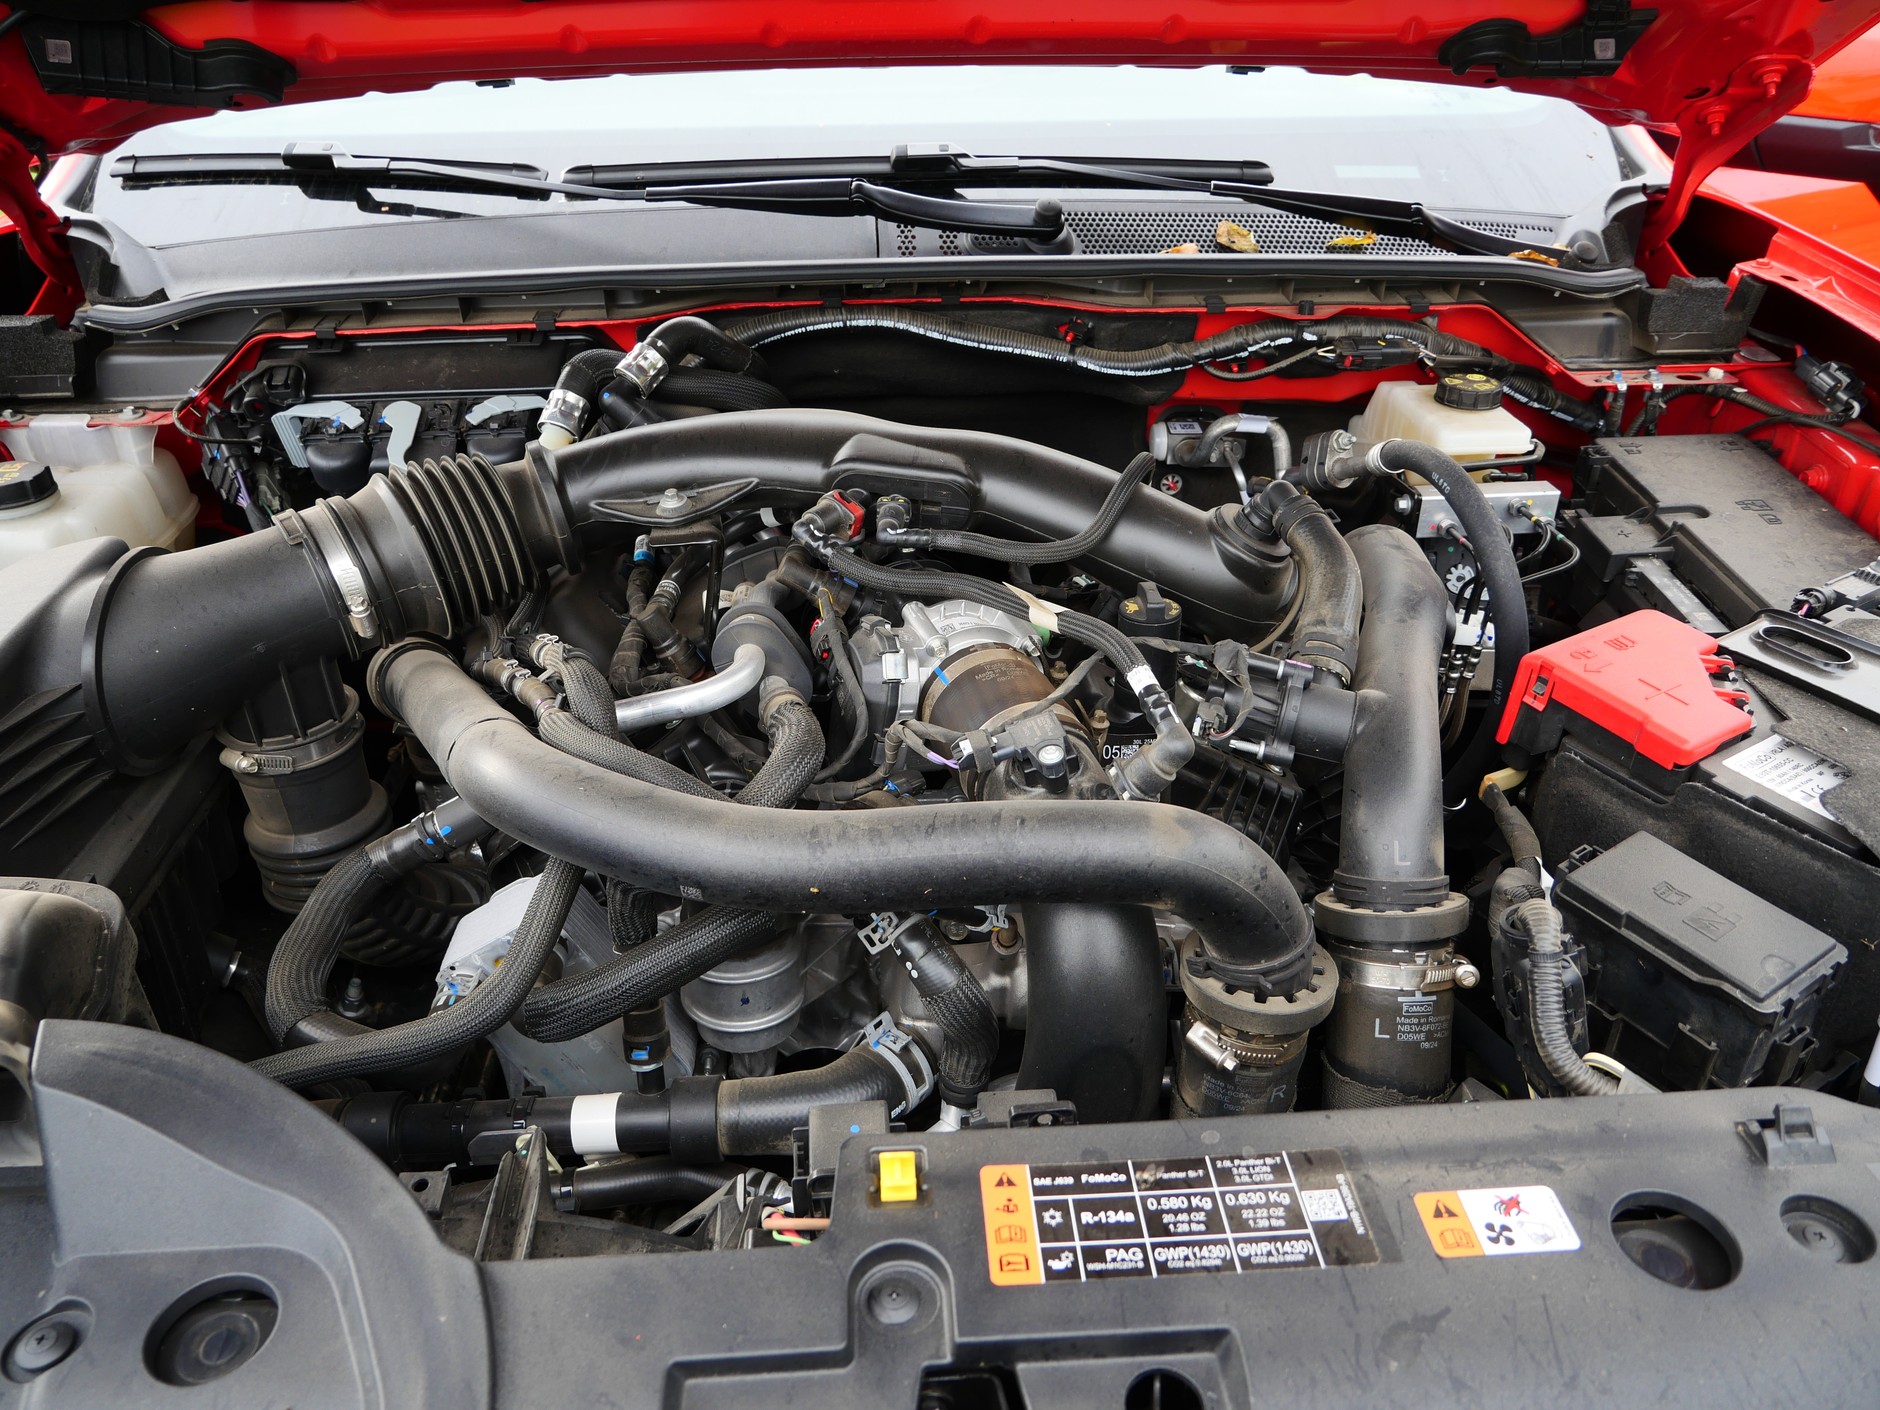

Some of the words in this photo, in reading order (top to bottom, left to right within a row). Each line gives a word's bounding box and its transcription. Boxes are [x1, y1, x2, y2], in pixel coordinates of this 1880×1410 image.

[1103, 745, 1120, 759] 05
[1393, 840, 1411, 866] L
[1403, 1005, 1432, 1013] FoMoCo
[1396, 1016, 1419, 1024] Made
[1375, 1018, 1390, 1039] L
[1397, 1032, 1426, 1041] D05WE
[1420, 1041, 1438, 1049] 09/24
[1203, 1073, 1225, 1088] Made
[1270, 1084, 1287, 1103] R
[1233, 1157, 1264, 1168] Panther
[1033, 1177, 1052, 1187] SAE
[1080, 1172, 1127, 1184] FoMoCo
[1146, 1196, 1189, 1211] 0.580
[1190, 1195, 1213, 1211] Kg
[1224, 1191, 1266, 1206] 0.630
[1268, 1190, 1291, 1206] Kg
[1080, 1210, 1136, 1225] R-134a
[1190, 1211, 1207, 1222] OZ
[1241, 1208, 1269, 1219] 22.22
[1269, 1207, 1286, 1218] OZ
[1190, 1221, 1207, 1232] lbs
[1269, 1216, 1286, 1227] lbs
[1105, 1247, 1144, 1261] PAG
[1154, 1243, 1231, 1262] GWP(1430)
[1236, 1239, 1314, 1258] GWP(1430)
